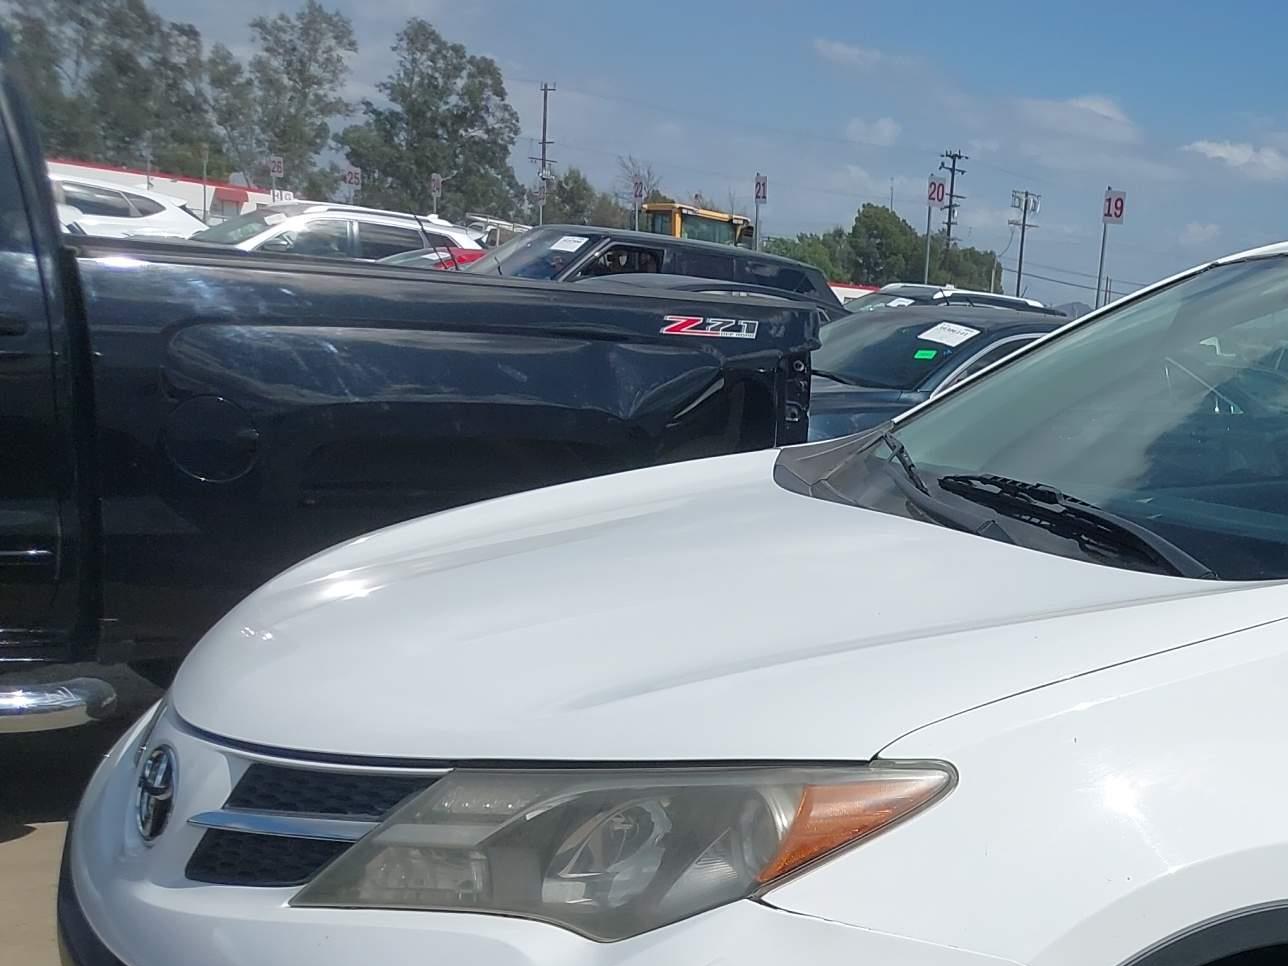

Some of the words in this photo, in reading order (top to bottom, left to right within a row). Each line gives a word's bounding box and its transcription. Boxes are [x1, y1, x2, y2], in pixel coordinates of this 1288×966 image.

[347, 171, 360, 186] 25
[633, 181, 644, 198] 22
[755, 182, 767, 199] 21
[928, 182, 945, 202] 20
[1104, 197, 1125, 218] 19
[660, 315, 759, 339] Z71
